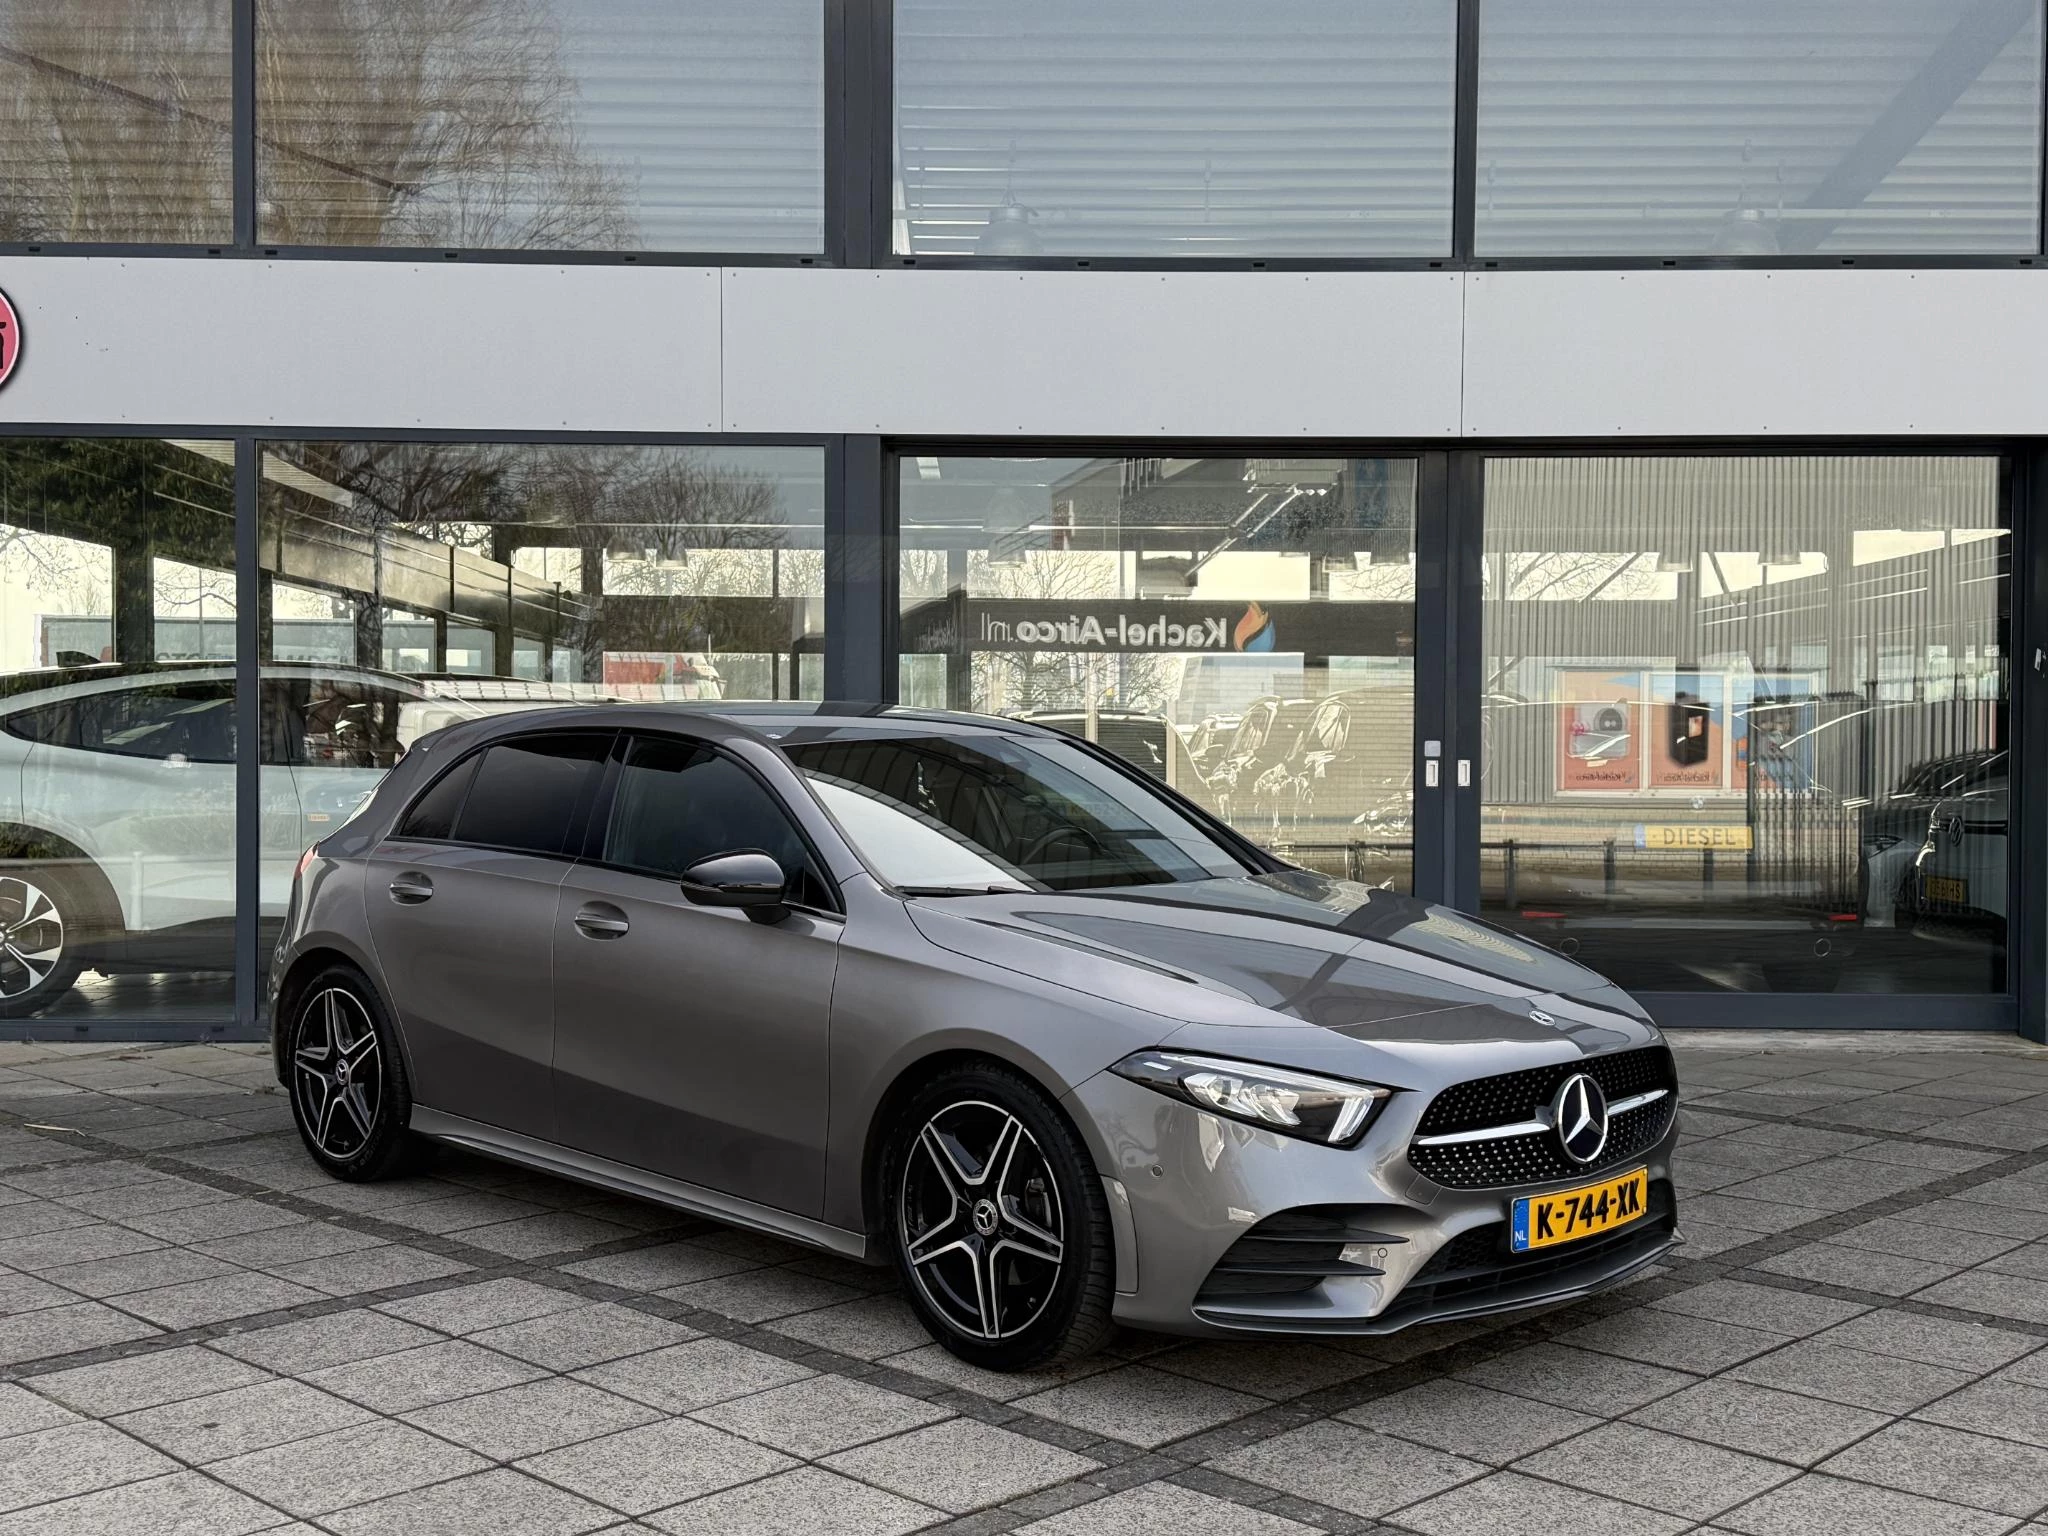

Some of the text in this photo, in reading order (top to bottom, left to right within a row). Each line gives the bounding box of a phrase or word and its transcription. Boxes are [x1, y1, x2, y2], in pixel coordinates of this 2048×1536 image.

[1663, 828, 1737, 846] DIESEL
[1537, 1178, 1640, 1240] K-744-XK
[1514, 1230, 1527, 1241] NL
